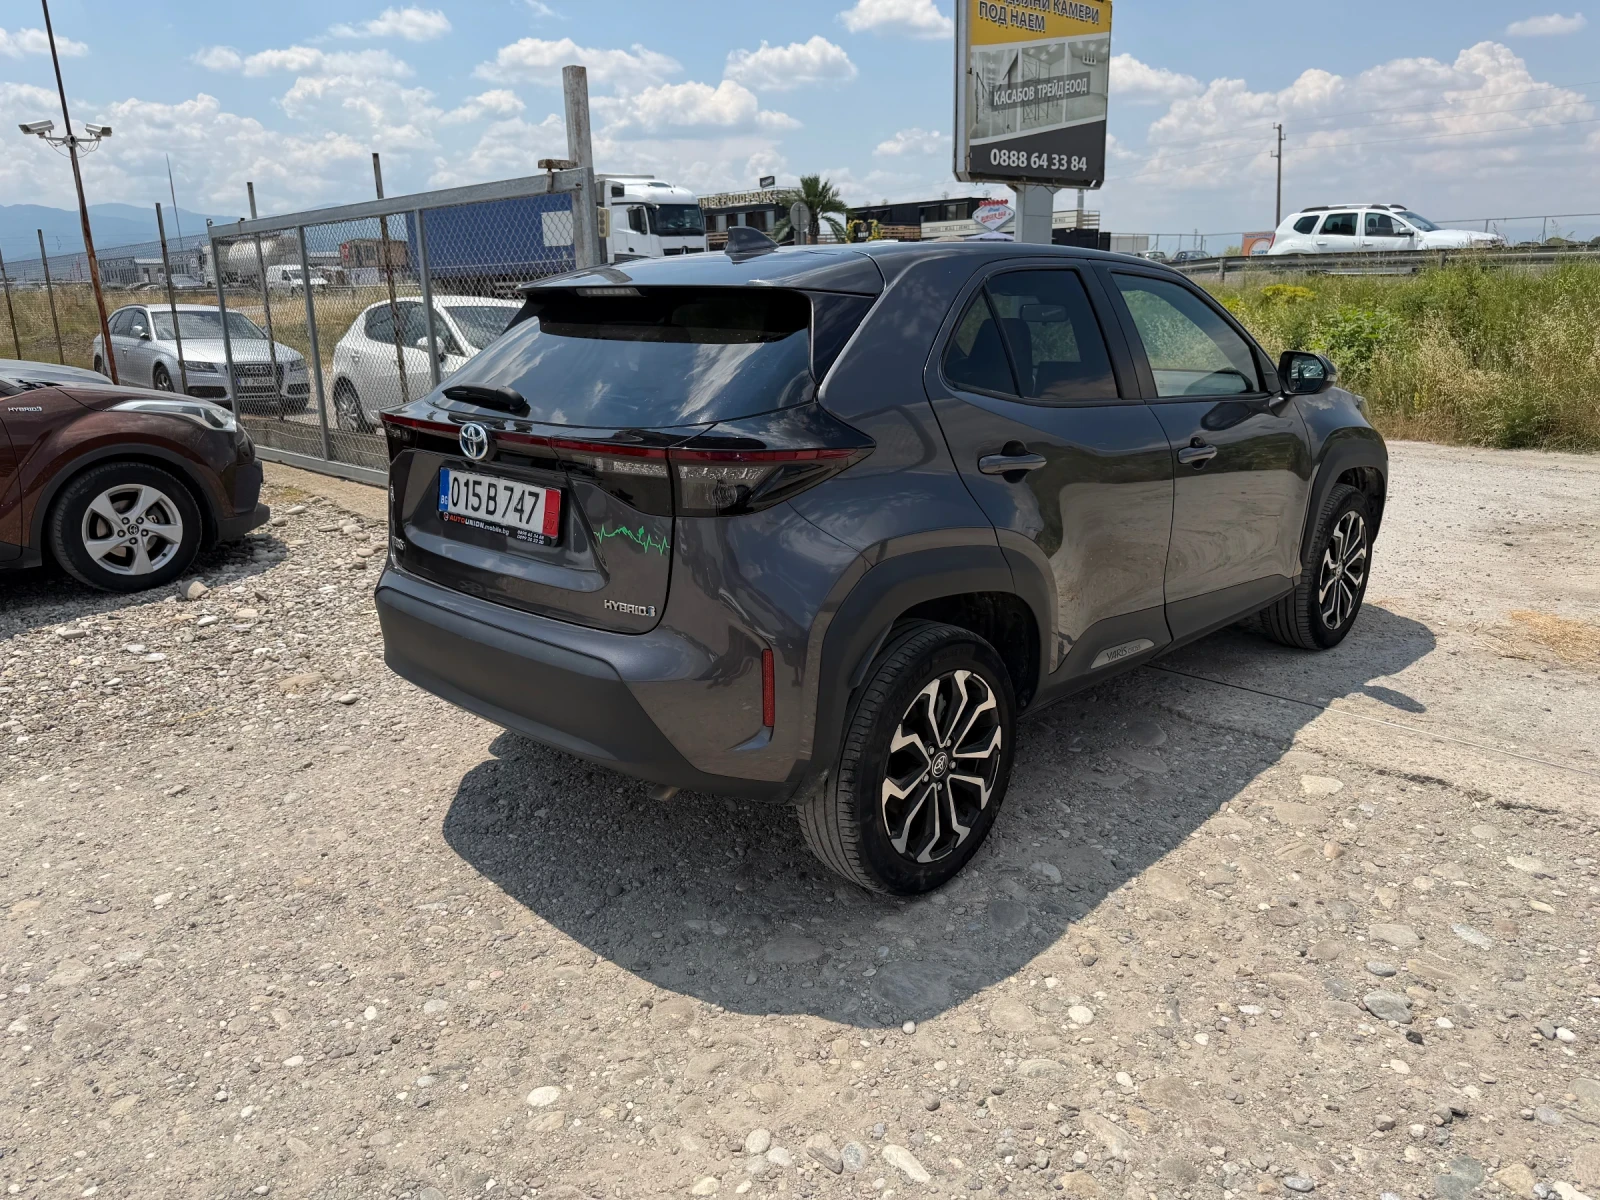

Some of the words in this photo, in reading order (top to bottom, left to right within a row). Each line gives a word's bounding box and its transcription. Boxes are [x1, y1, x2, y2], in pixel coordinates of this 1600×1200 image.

[979, 1, 1008, 26] ПОД
[1010, 9, 1045, 31] НАЕМ
[1053, 0, 1099, 24] КАМЕРИ
[993, 86, 1035, 106] КАСАБОВ
[1037, 80, 1064, 98] ТРЕЙД
[1065, 78, 1088, 94] ЕООД
[990, 148, 1028, 168] 0888
[1030, 152, 1048, 169] 64
[1051, 154, 1068, 171] 33
[1070, 155, 1088, 172] 84
[747, 190, 774, 203] PARK
[440, 494, 449, 505] BG
[604, 599, 647, 616] HYBRID
[1106, 646, 1128, 661] YARIS
